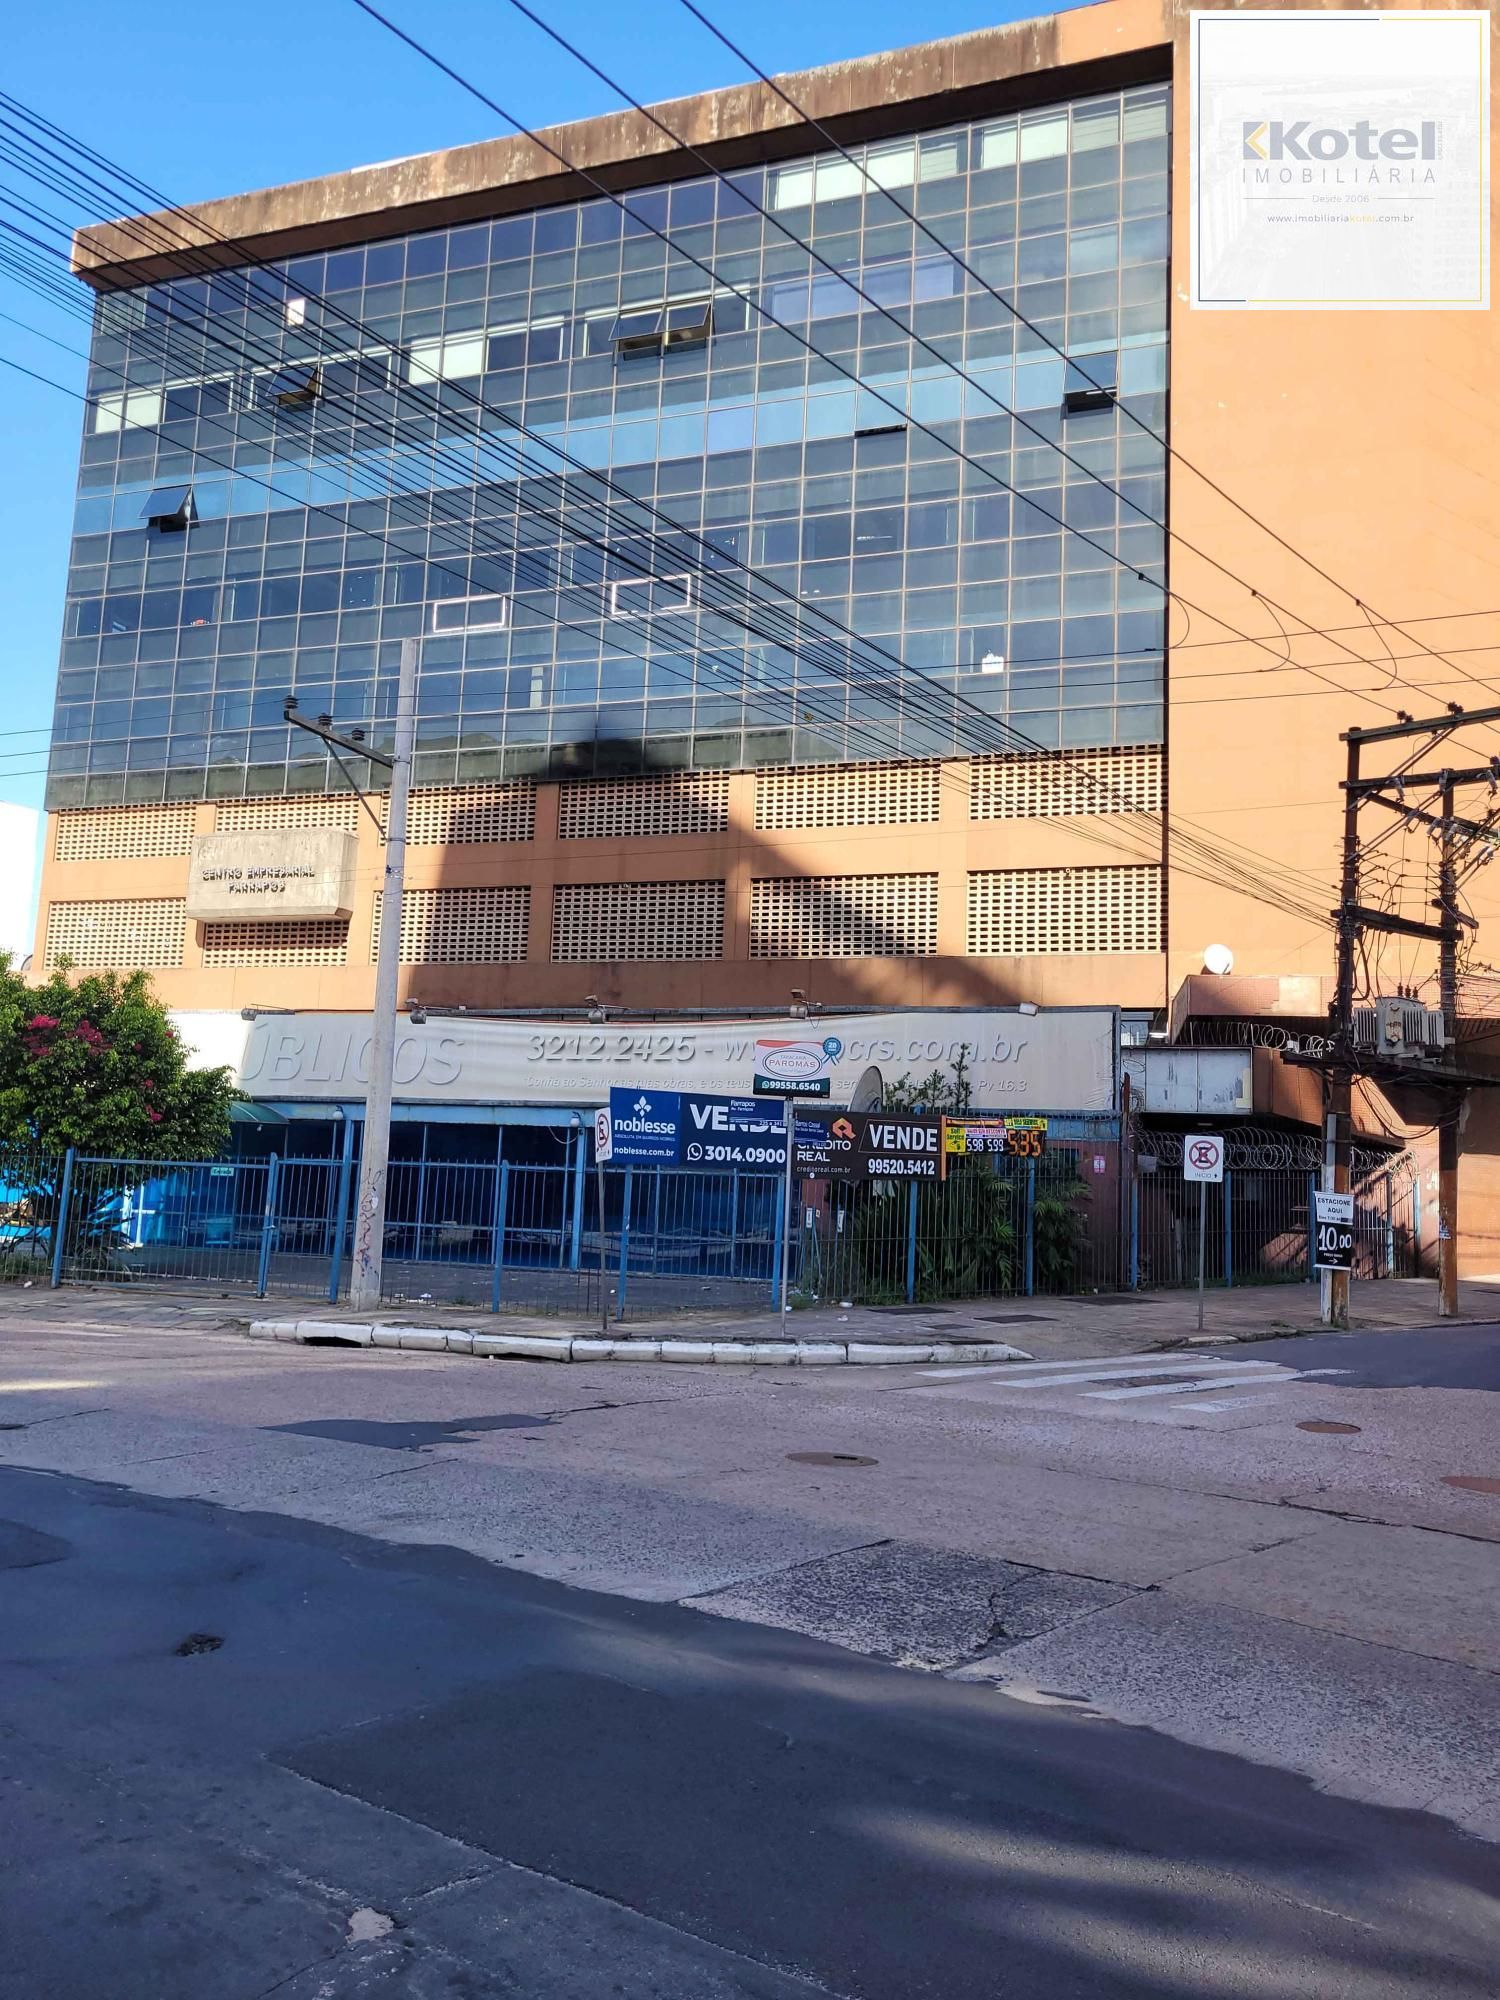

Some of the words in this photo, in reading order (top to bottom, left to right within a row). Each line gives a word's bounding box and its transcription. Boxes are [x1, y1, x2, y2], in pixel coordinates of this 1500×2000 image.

[202, 868, 243, 881] CENTRO
[247, 865, 316, 880] EMPRESARIAL
[228, 881, 286, 895] FARRAPOS
[527, 1033, 697, 1061] 3212.2425
[769, 1059, 816, 1068] PAROMAS
[769, 1080, 820, 1091] 99558.6540
[731, 1100, 756, 1108] Farrapos
[614, 1117, 676, 1134] noblesse
[868, 1123, 938, 1151] VENDE
[614, 1146, 675, 1157] noblesse.com.br
[704, 1145, 786, 1164] 3014.0900
[797, 1151, 831, 1162] REAL
[868, 1158, 935, 1176] 99520.5412
[1317, 1197, 1351, 1206] ESTACIONE
[1318, 1224, 1352, 1251] 10,00
